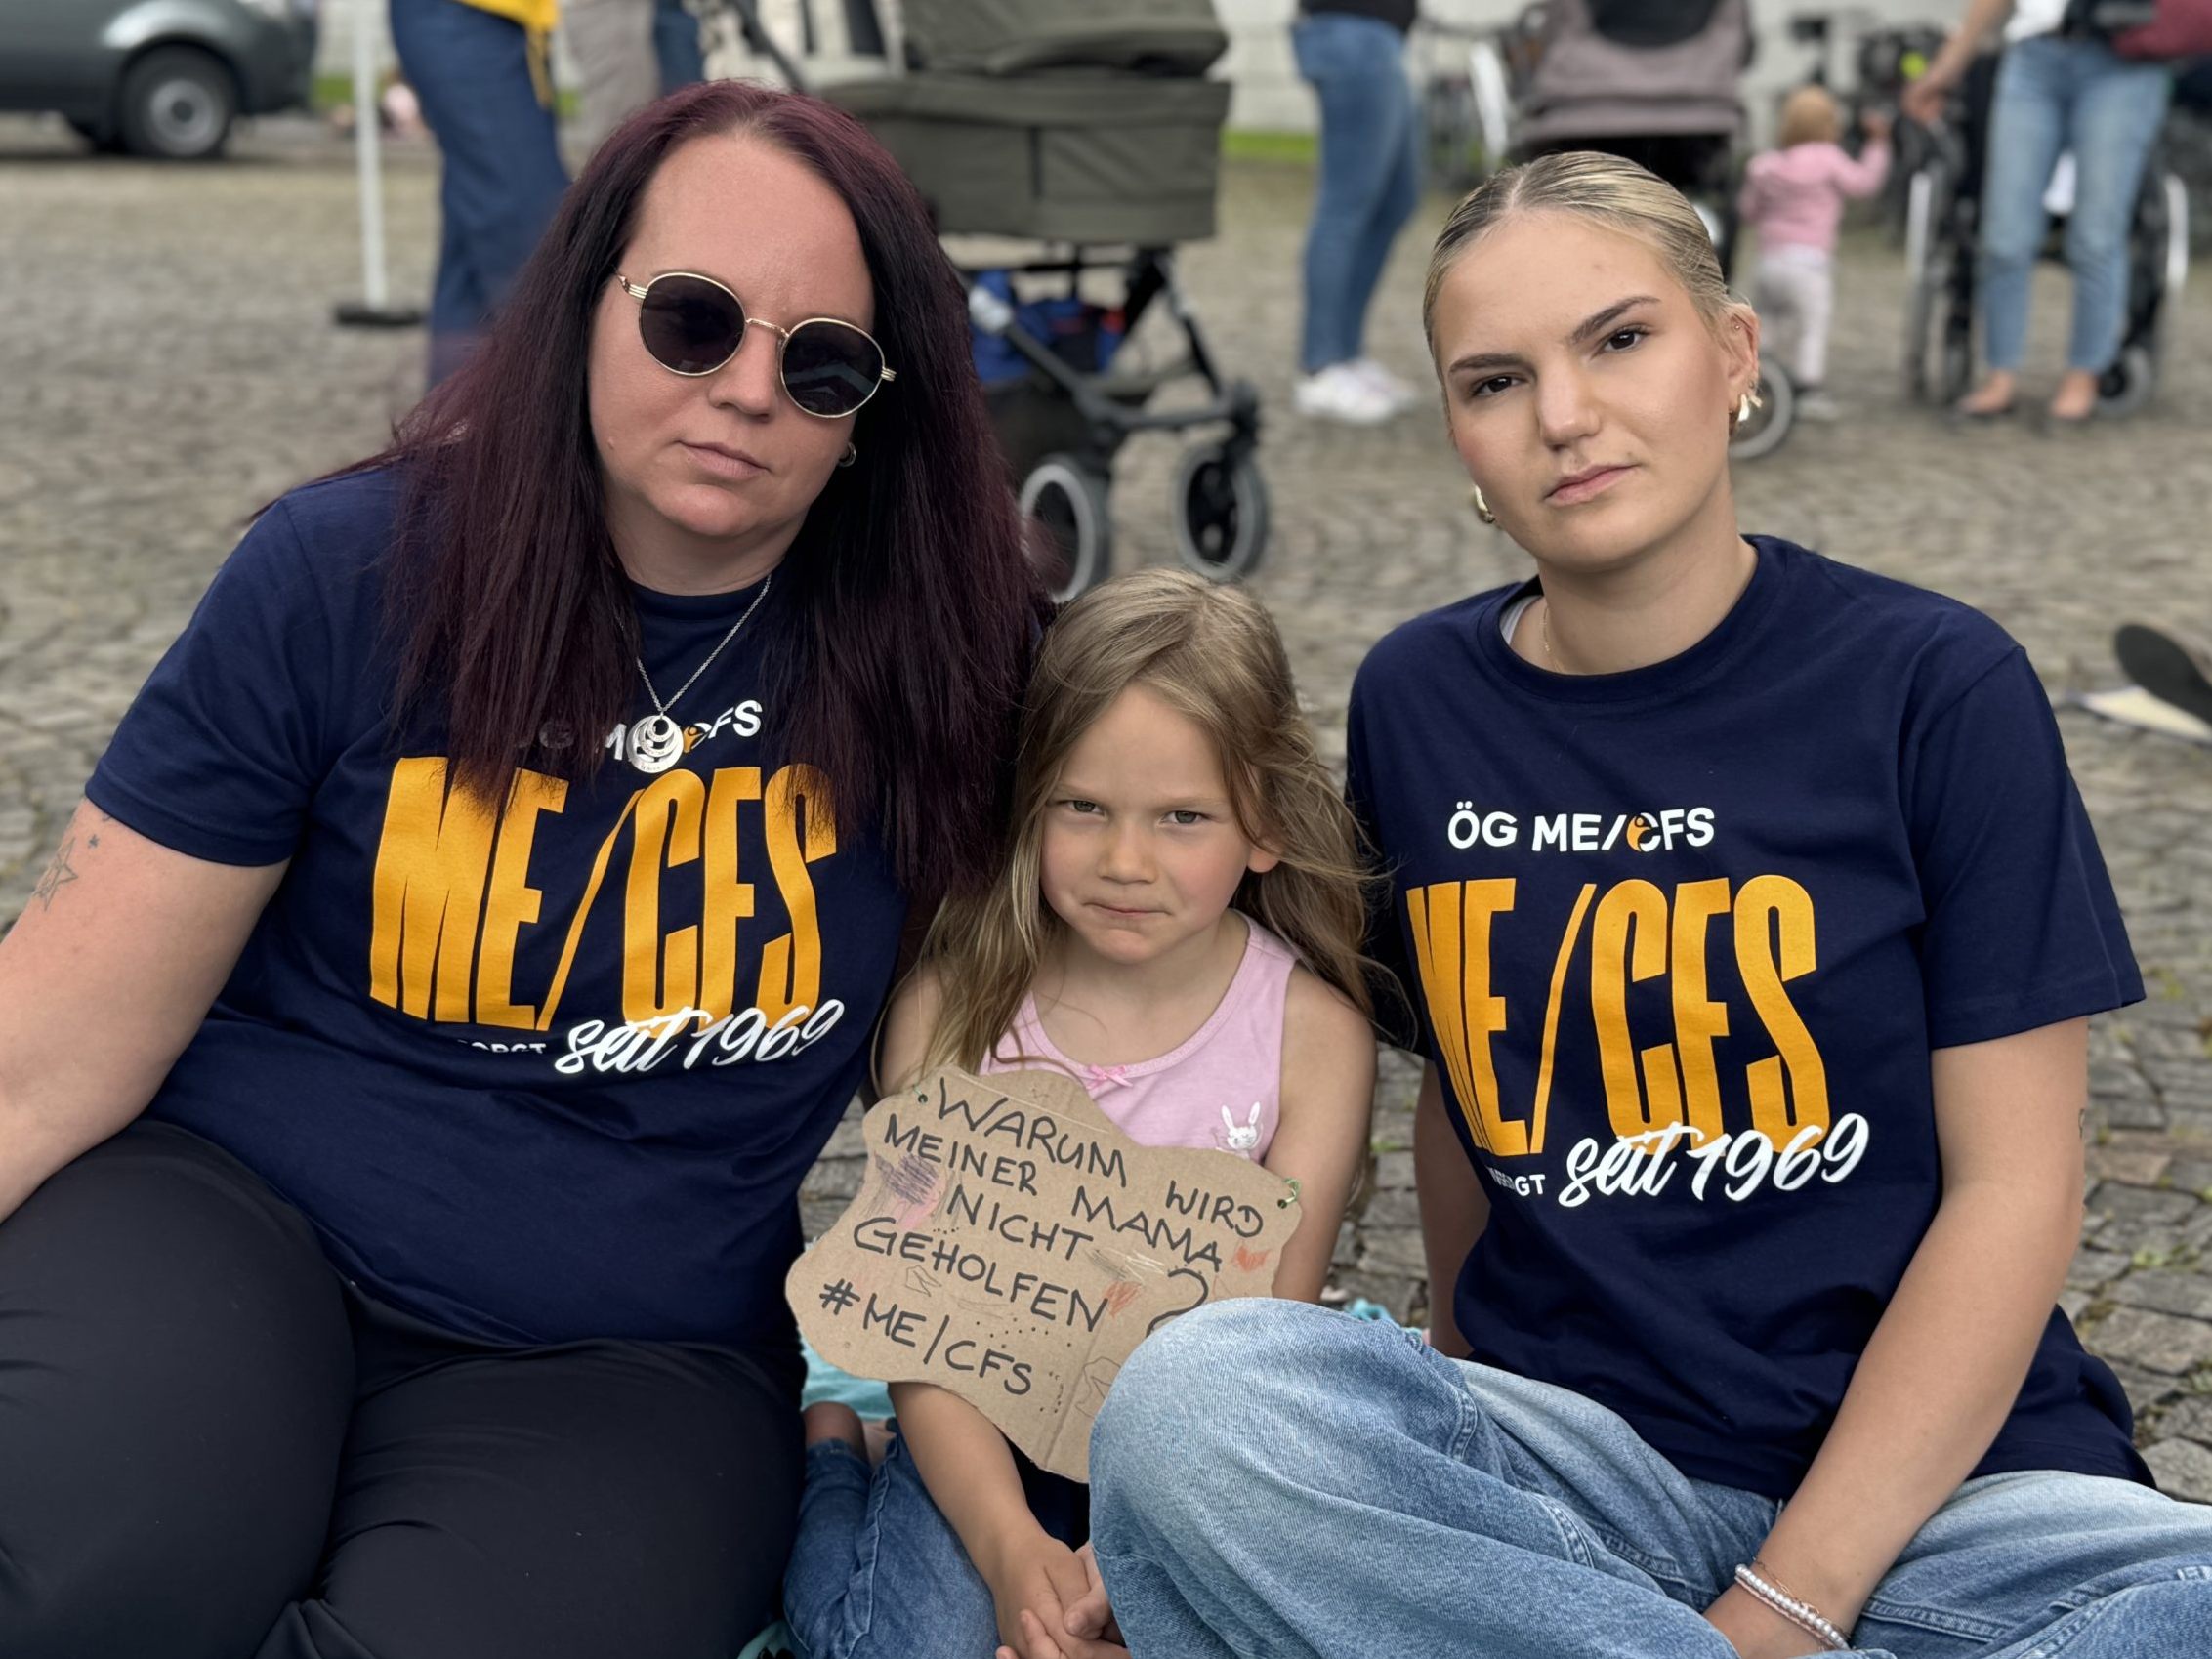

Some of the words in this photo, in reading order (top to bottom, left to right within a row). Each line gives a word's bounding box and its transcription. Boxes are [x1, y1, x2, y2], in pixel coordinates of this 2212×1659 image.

[1447, 800, 1518, 850] ÖG
[1531, 807, 1715, 852] ME/CFS
[369, 756, 837, 1038] ME/CFS
[555, 1005, 713, 1074] seit
[684, 998, 846, 1070] 1969
[1406, 875, 1830, 1156] ME/CFS
[884, 1113, 1037, 1196] MEINER
[1071, 1185, 1223, 1273] MAMA
[939, 1076, 1127, 1188] WARUM
[1165, 1180, 1264, 1238] WIRD
[1558, 1120, 1705, 1208] seit
[1685, 1112, 1870, 1202] 1969
[853, 1217, 1109, 1333] GEHOLFEN
[946, 1184, 1094, 1261] NICHT
[819, 1277, 1033, 1396] #ME/CFS
